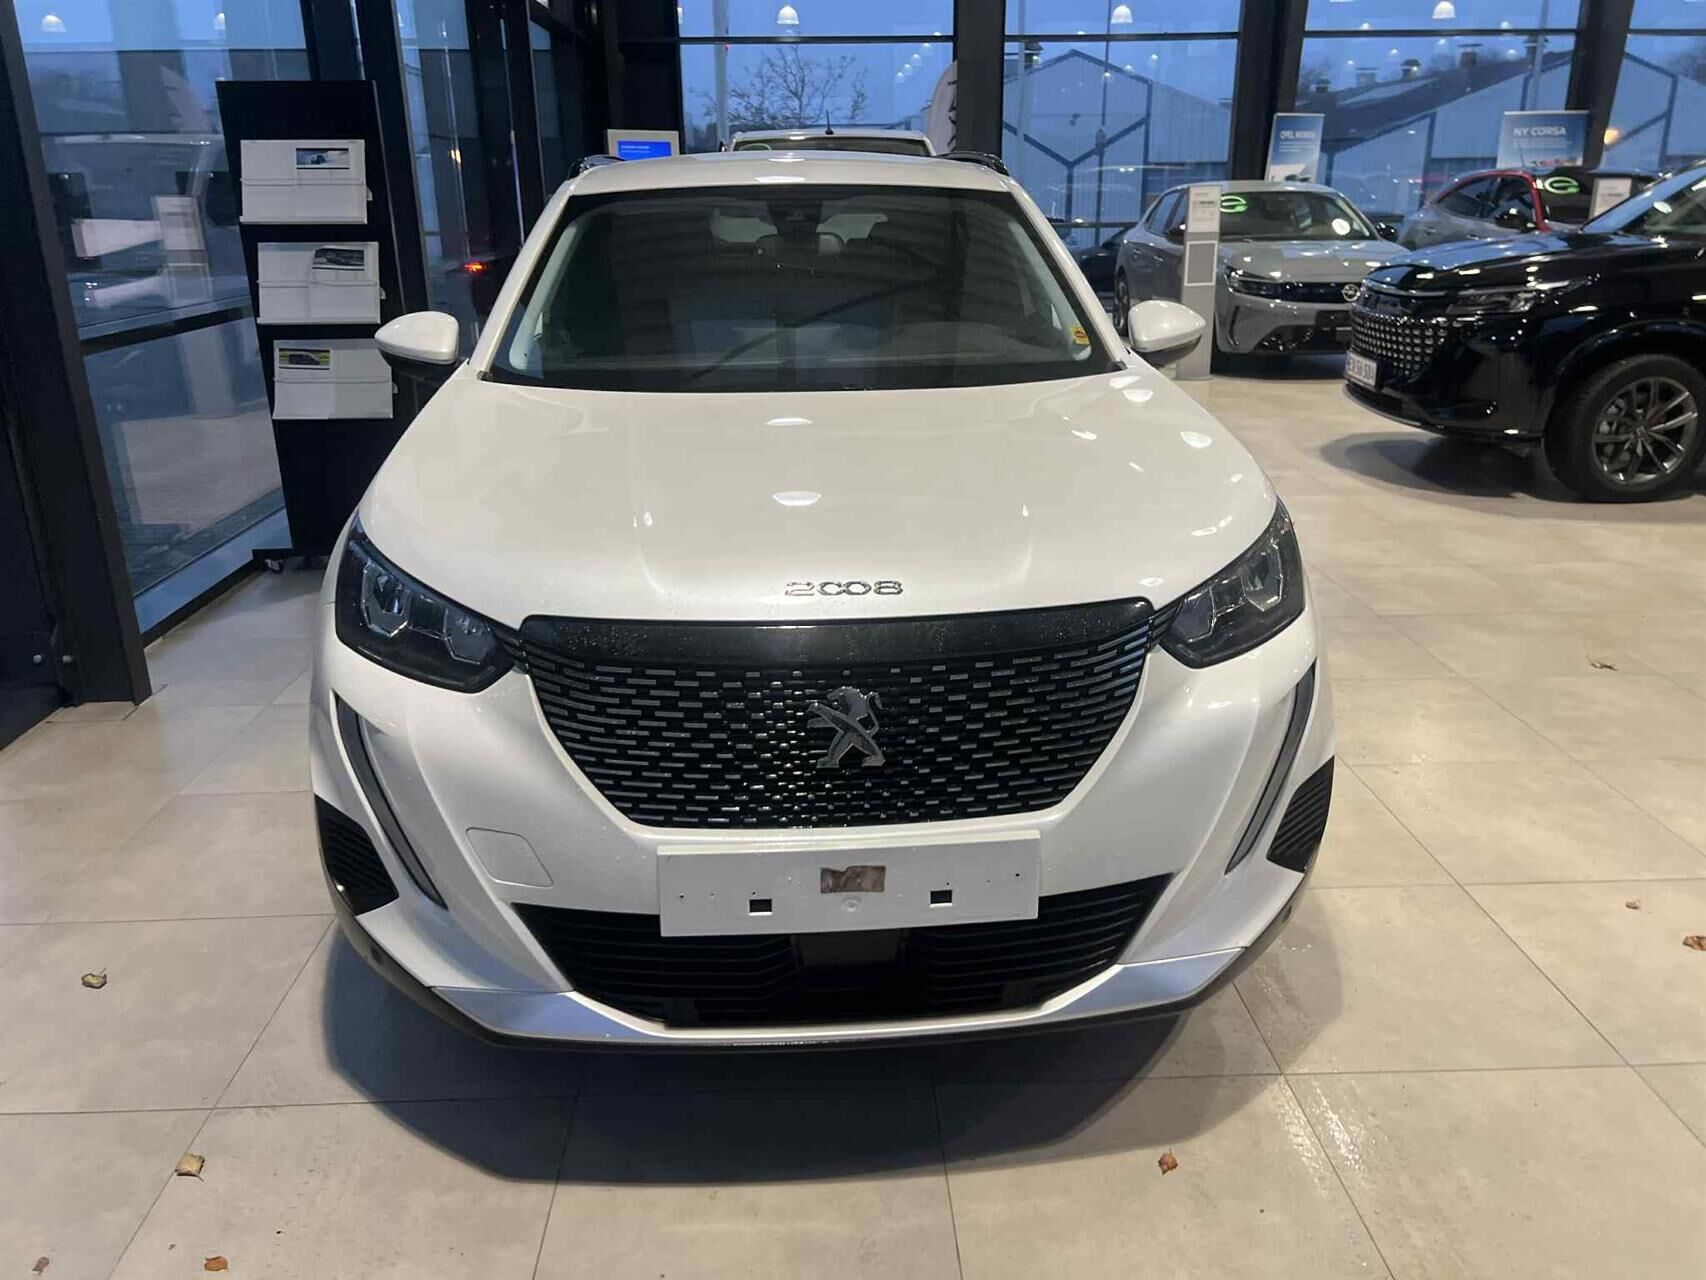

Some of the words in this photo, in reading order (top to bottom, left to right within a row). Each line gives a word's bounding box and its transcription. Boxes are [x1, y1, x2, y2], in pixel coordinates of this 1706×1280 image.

[1513, 127, 1529, 137] NY
[1530, 126, 1567, 137] CORSA
[784, 580, 904, 597] 2008
